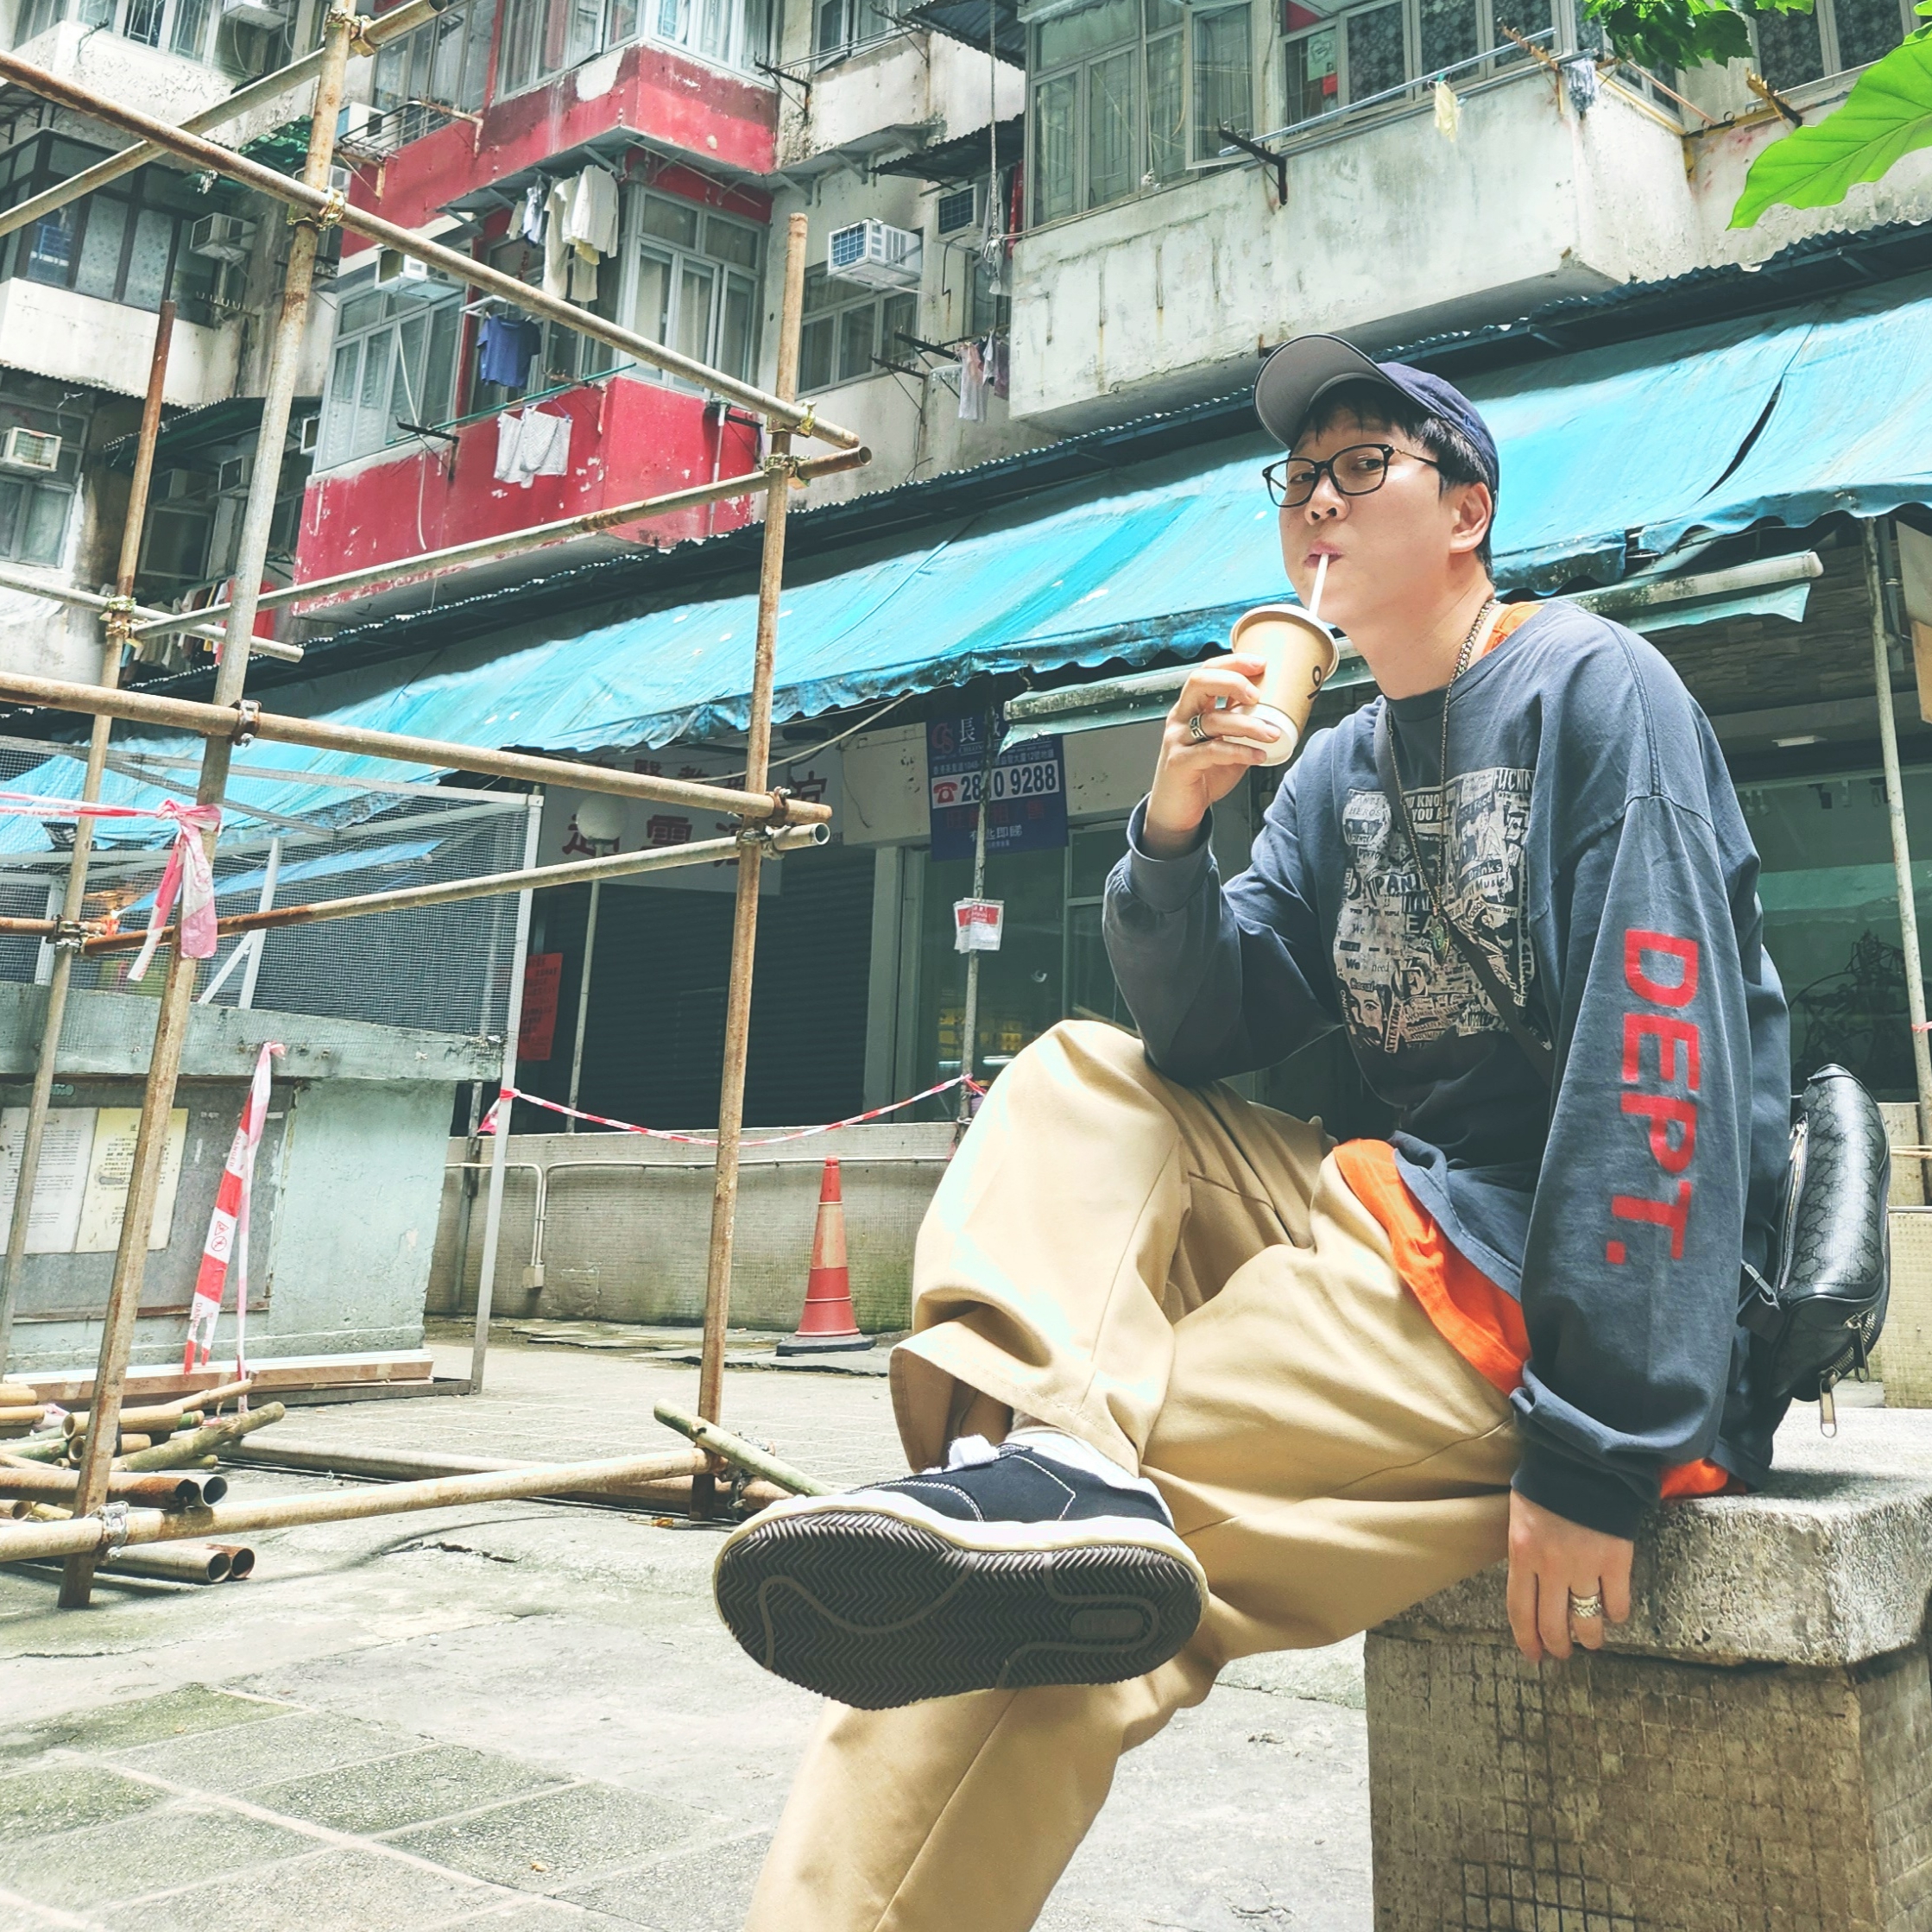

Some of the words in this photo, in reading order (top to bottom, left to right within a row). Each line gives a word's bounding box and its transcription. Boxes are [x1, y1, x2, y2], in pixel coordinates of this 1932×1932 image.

[961, 770, 1005, 803] 280
[1010, 763, 1057, 795] 9288
[1411, 808, 1433, 821] YOU
[1468, 862, 1502, 881] Drinks
[1386, 1002, 1402, 1052] ATTENTION
[1606, 929, 1700, 1264] DEPT.
